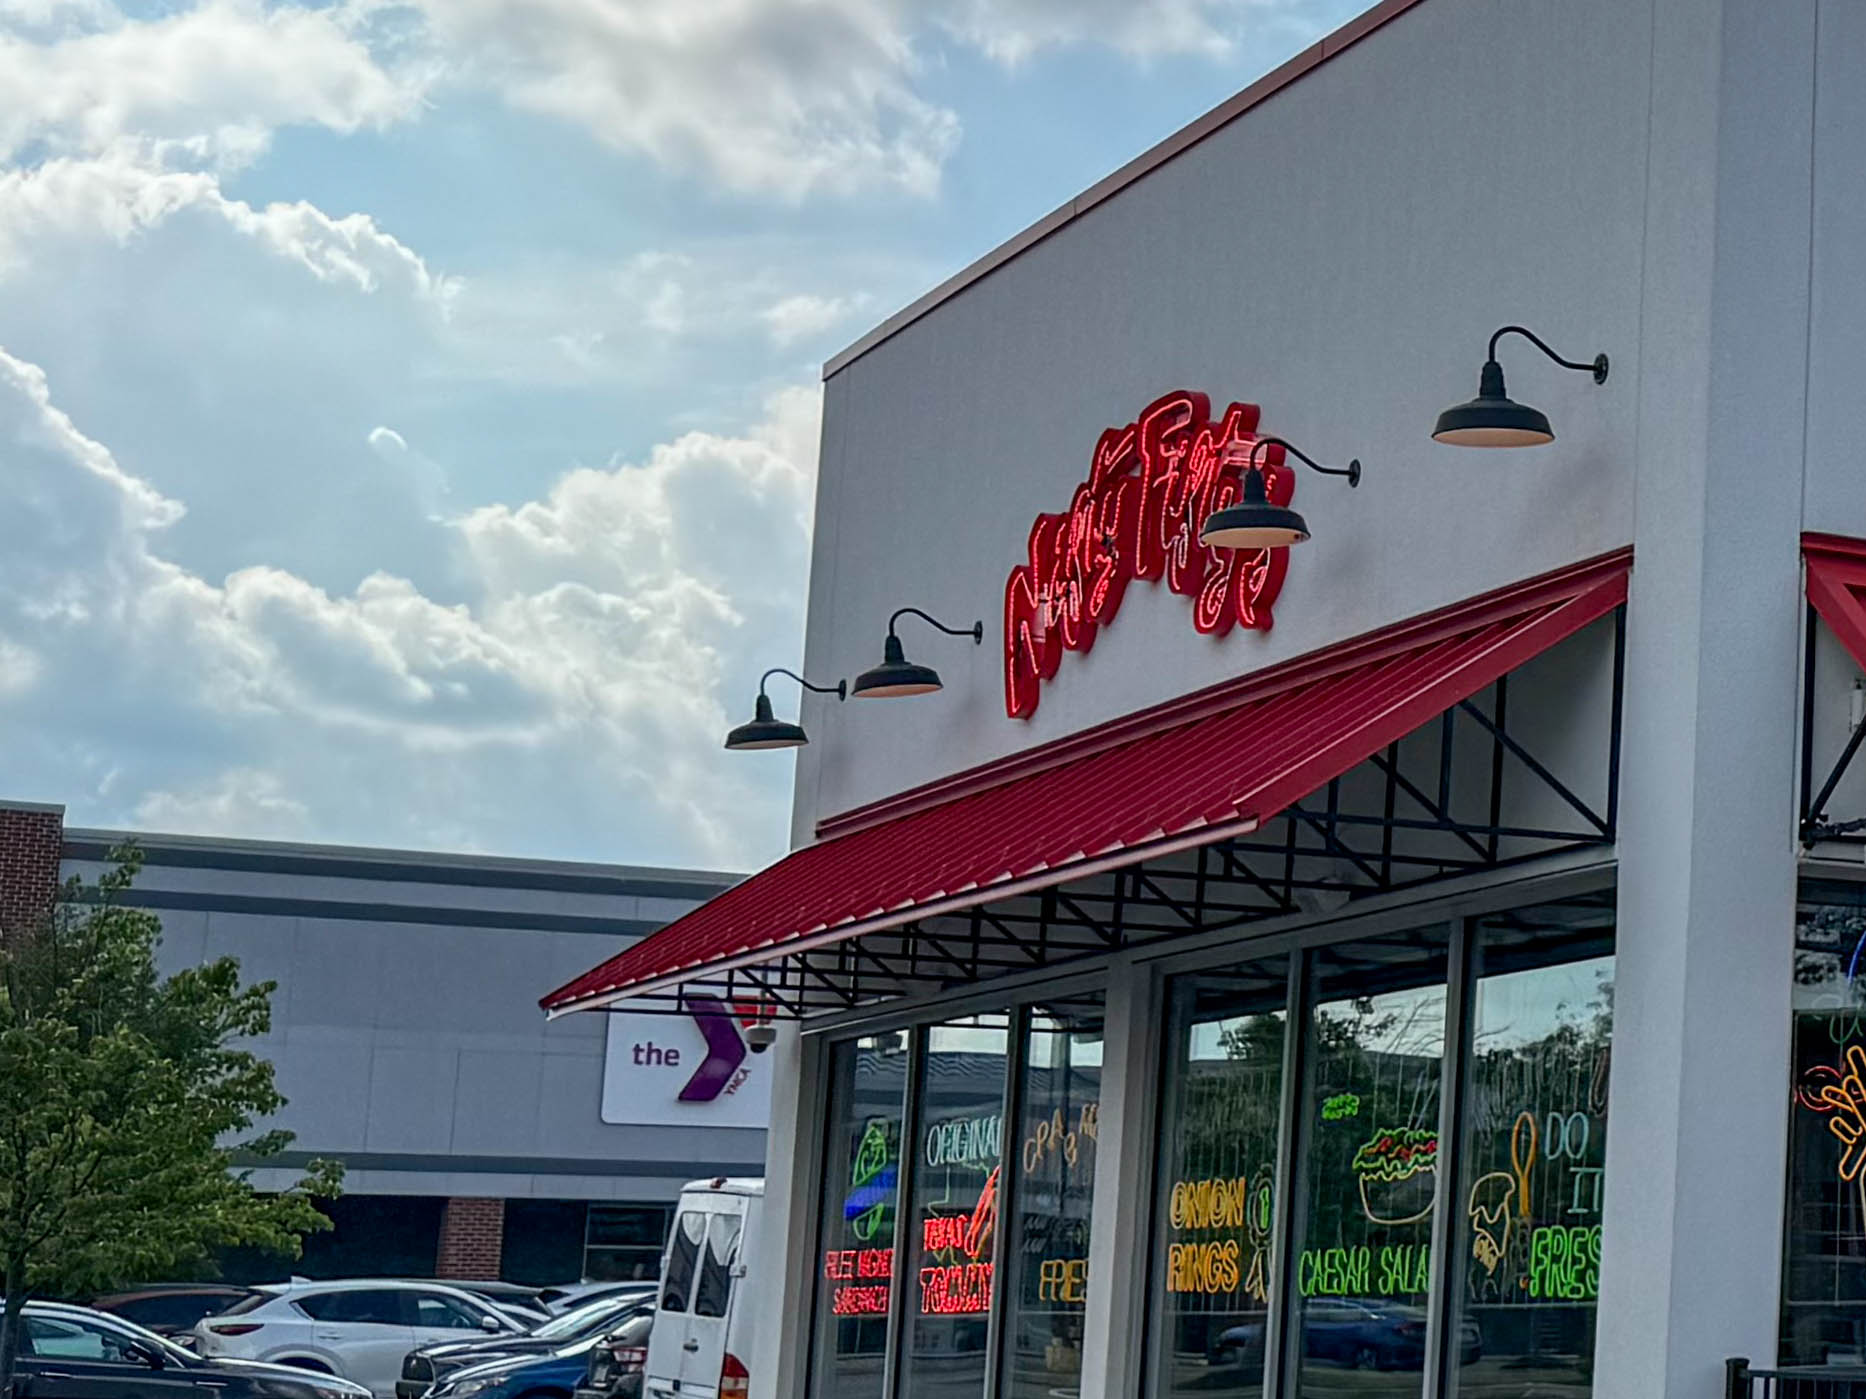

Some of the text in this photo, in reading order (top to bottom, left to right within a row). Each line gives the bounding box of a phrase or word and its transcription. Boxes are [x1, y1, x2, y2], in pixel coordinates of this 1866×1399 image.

[632, 1040, 680, 1067] the
[1545, 1111, 1589, 1160] DO
[1169, 1176, 1246, 1231] ONION
[1167, 1239, 1240, 1293] RINGS
[1300, 1244, 1430, 1297] CAESAR SALA
[1530, 1225, 1603, 1299] FRES
